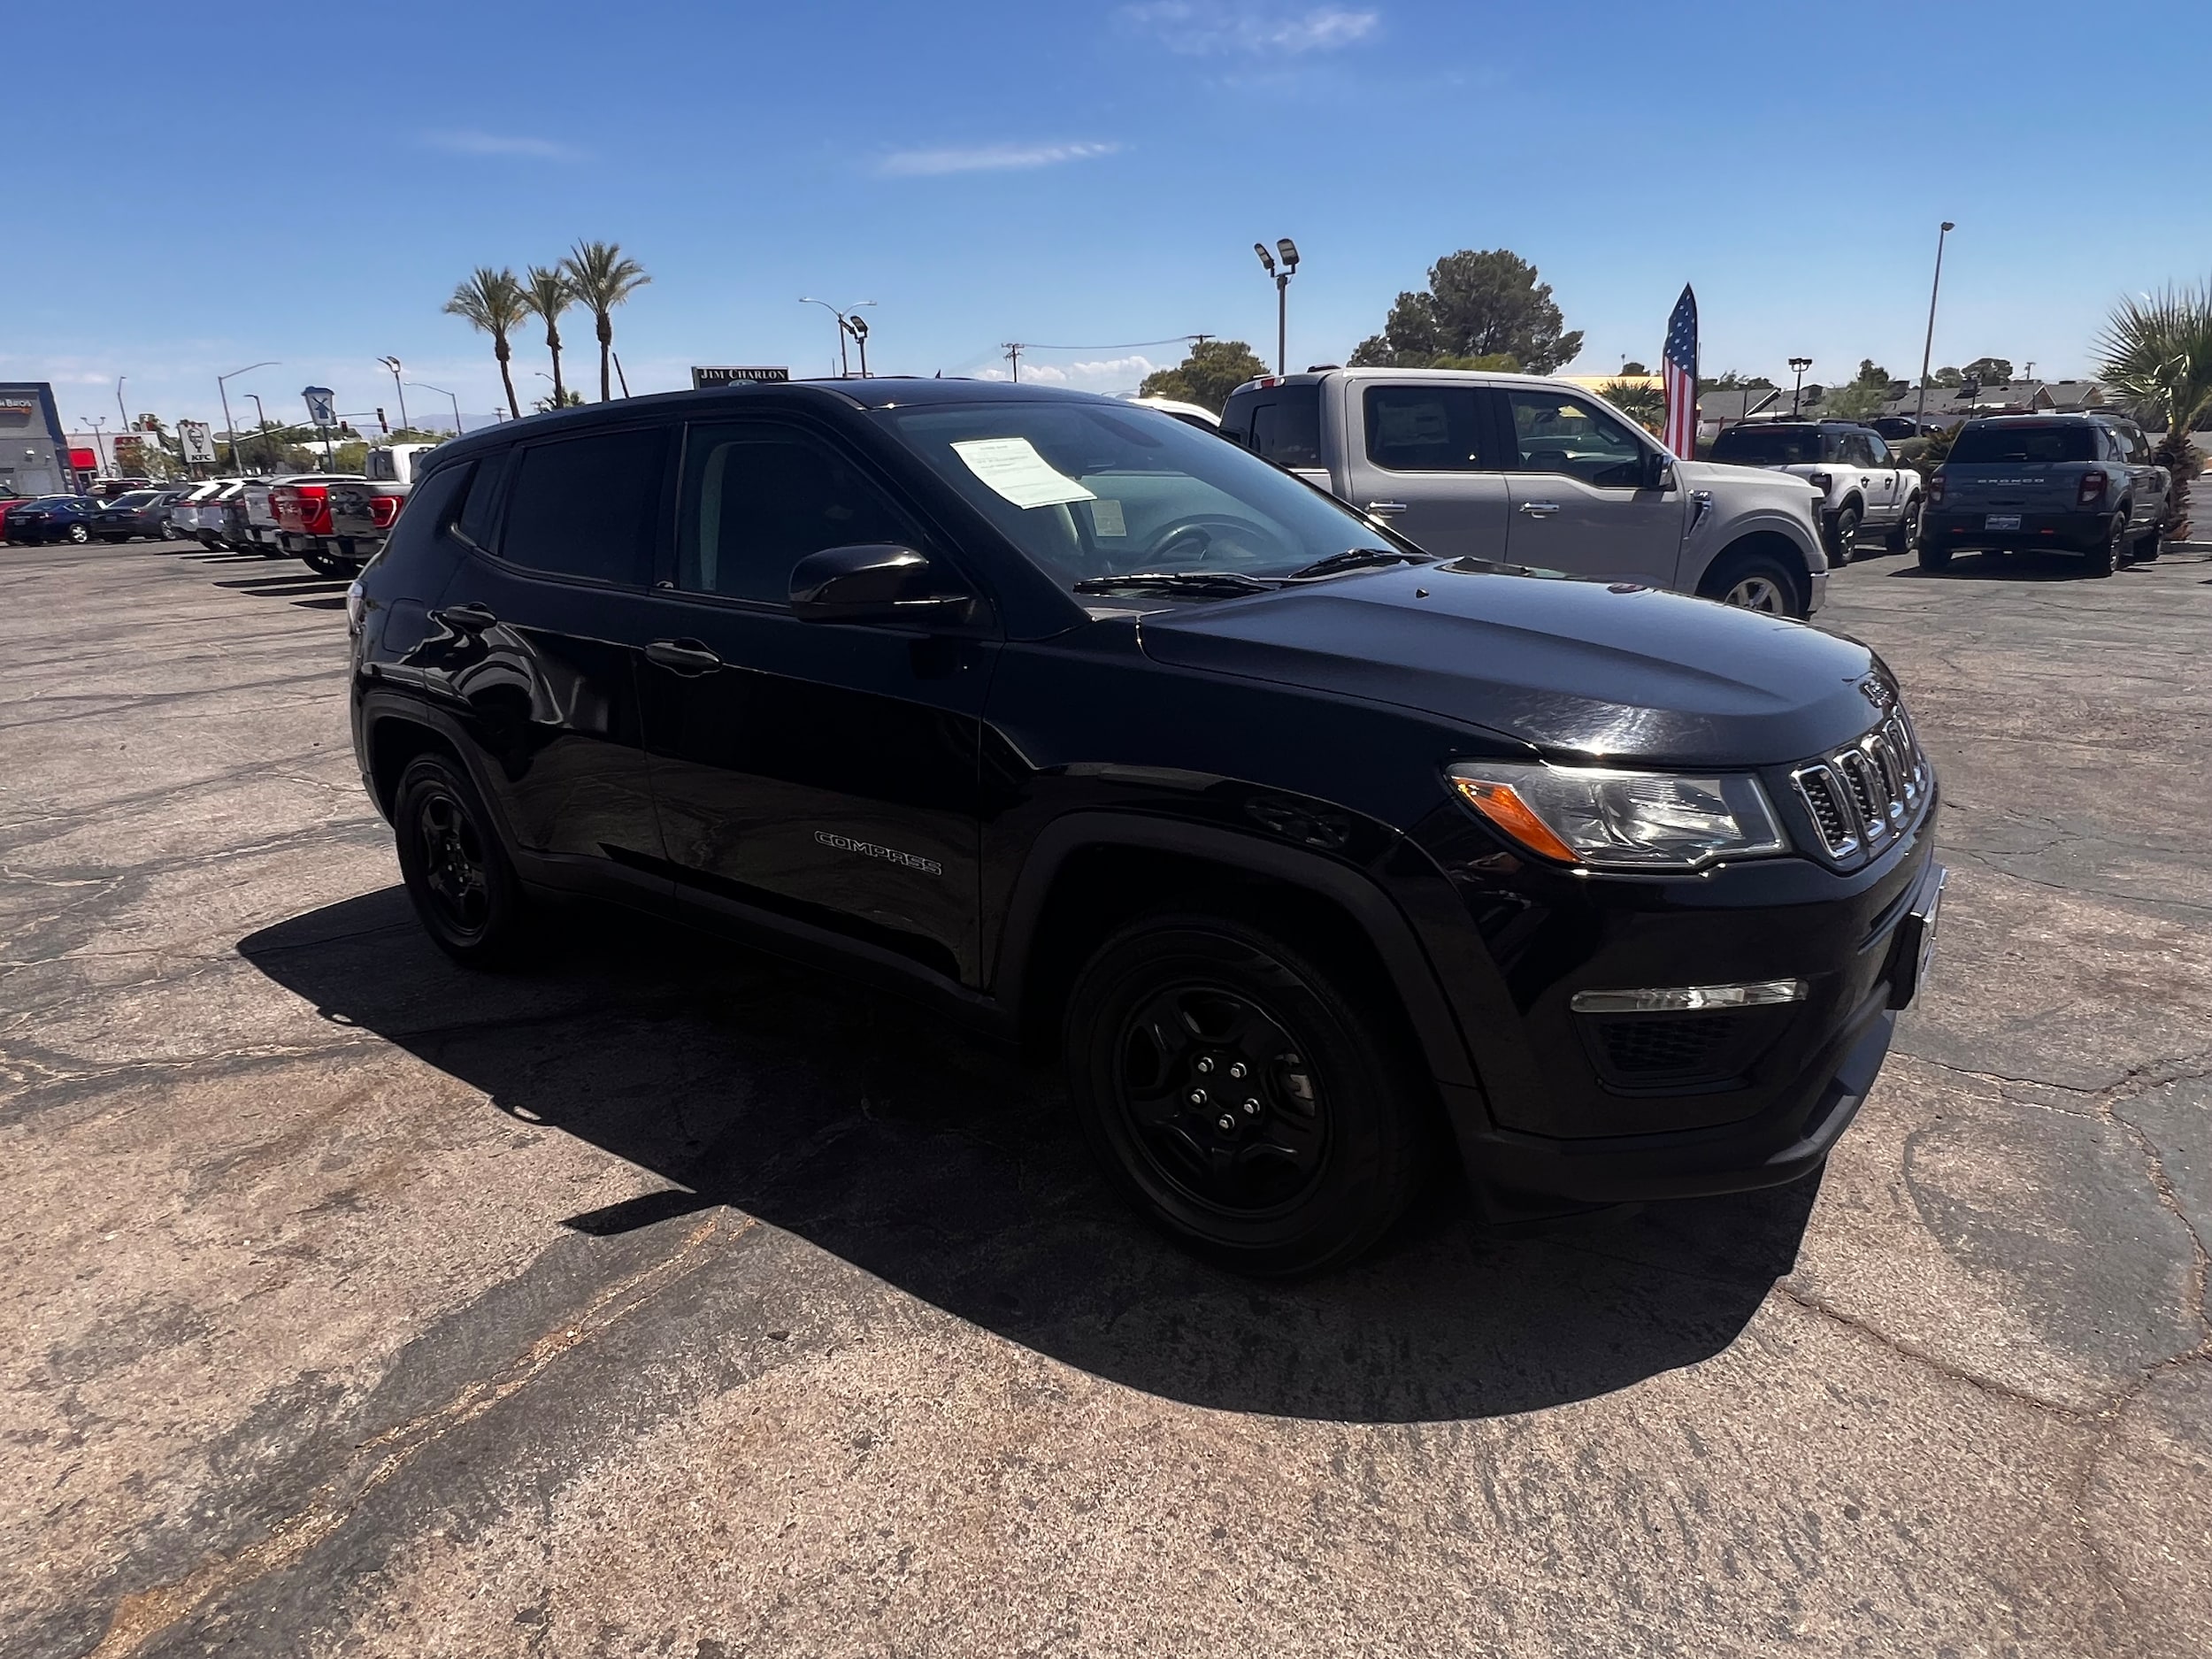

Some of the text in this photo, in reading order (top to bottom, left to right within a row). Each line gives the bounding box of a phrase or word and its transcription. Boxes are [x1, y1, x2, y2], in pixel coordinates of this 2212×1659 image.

[701, 368, 786, 379] JIM CHARLON
[814, 830, 941, 875] COMPASS
